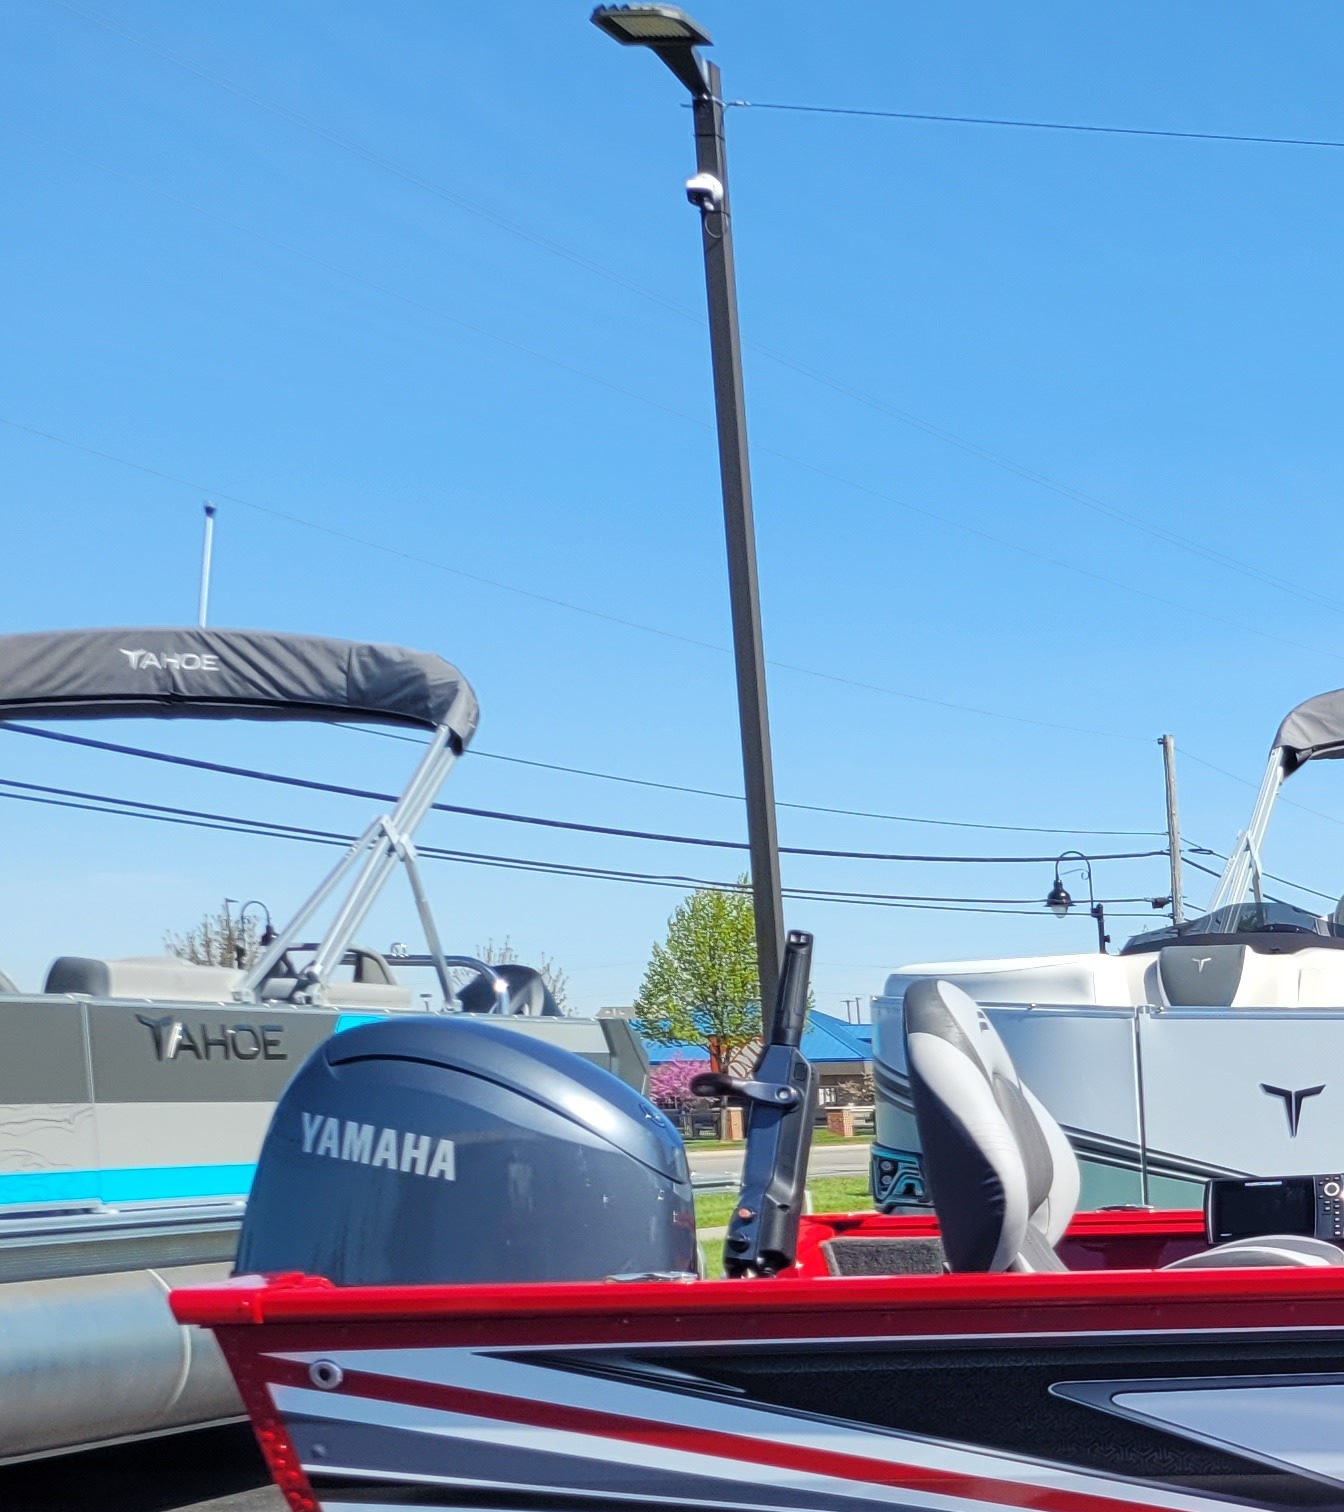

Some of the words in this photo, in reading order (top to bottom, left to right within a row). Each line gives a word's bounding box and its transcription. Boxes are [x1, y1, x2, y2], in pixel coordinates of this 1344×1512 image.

[119, 647, 220, 671] TAHOE
[136, 1013, 288, 1061] TAHOE
[301, 1112, 456, 1181] YAMAHA
